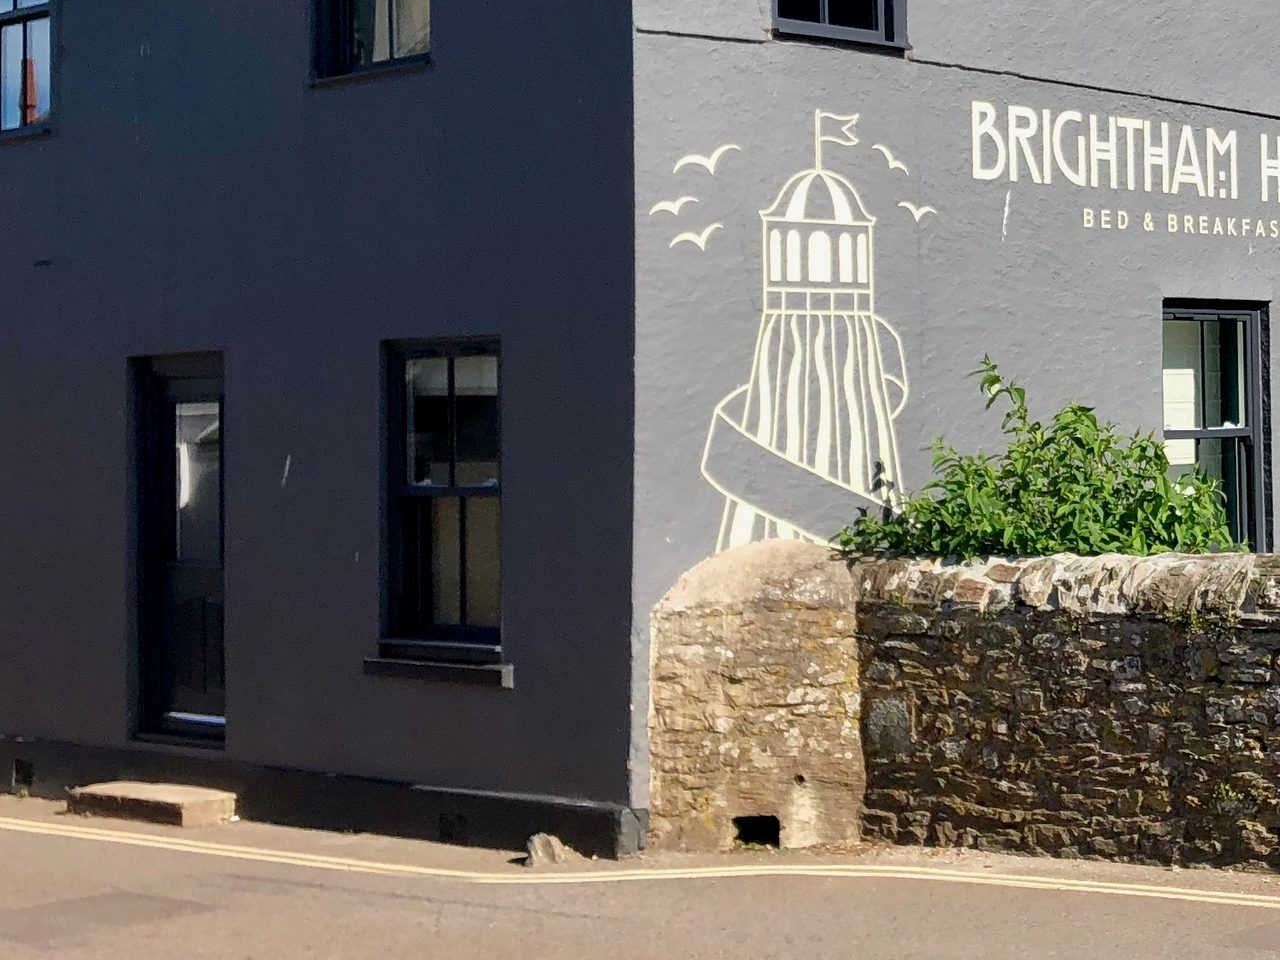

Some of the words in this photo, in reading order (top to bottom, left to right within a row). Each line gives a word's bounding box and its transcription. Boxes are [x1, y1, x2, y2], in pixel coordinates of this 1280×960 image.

[971, 100, 1239, 200] BRIGHTHAM
[1083, 207, 1129, 230] BED
[1143, 211, 1155, 232] &
